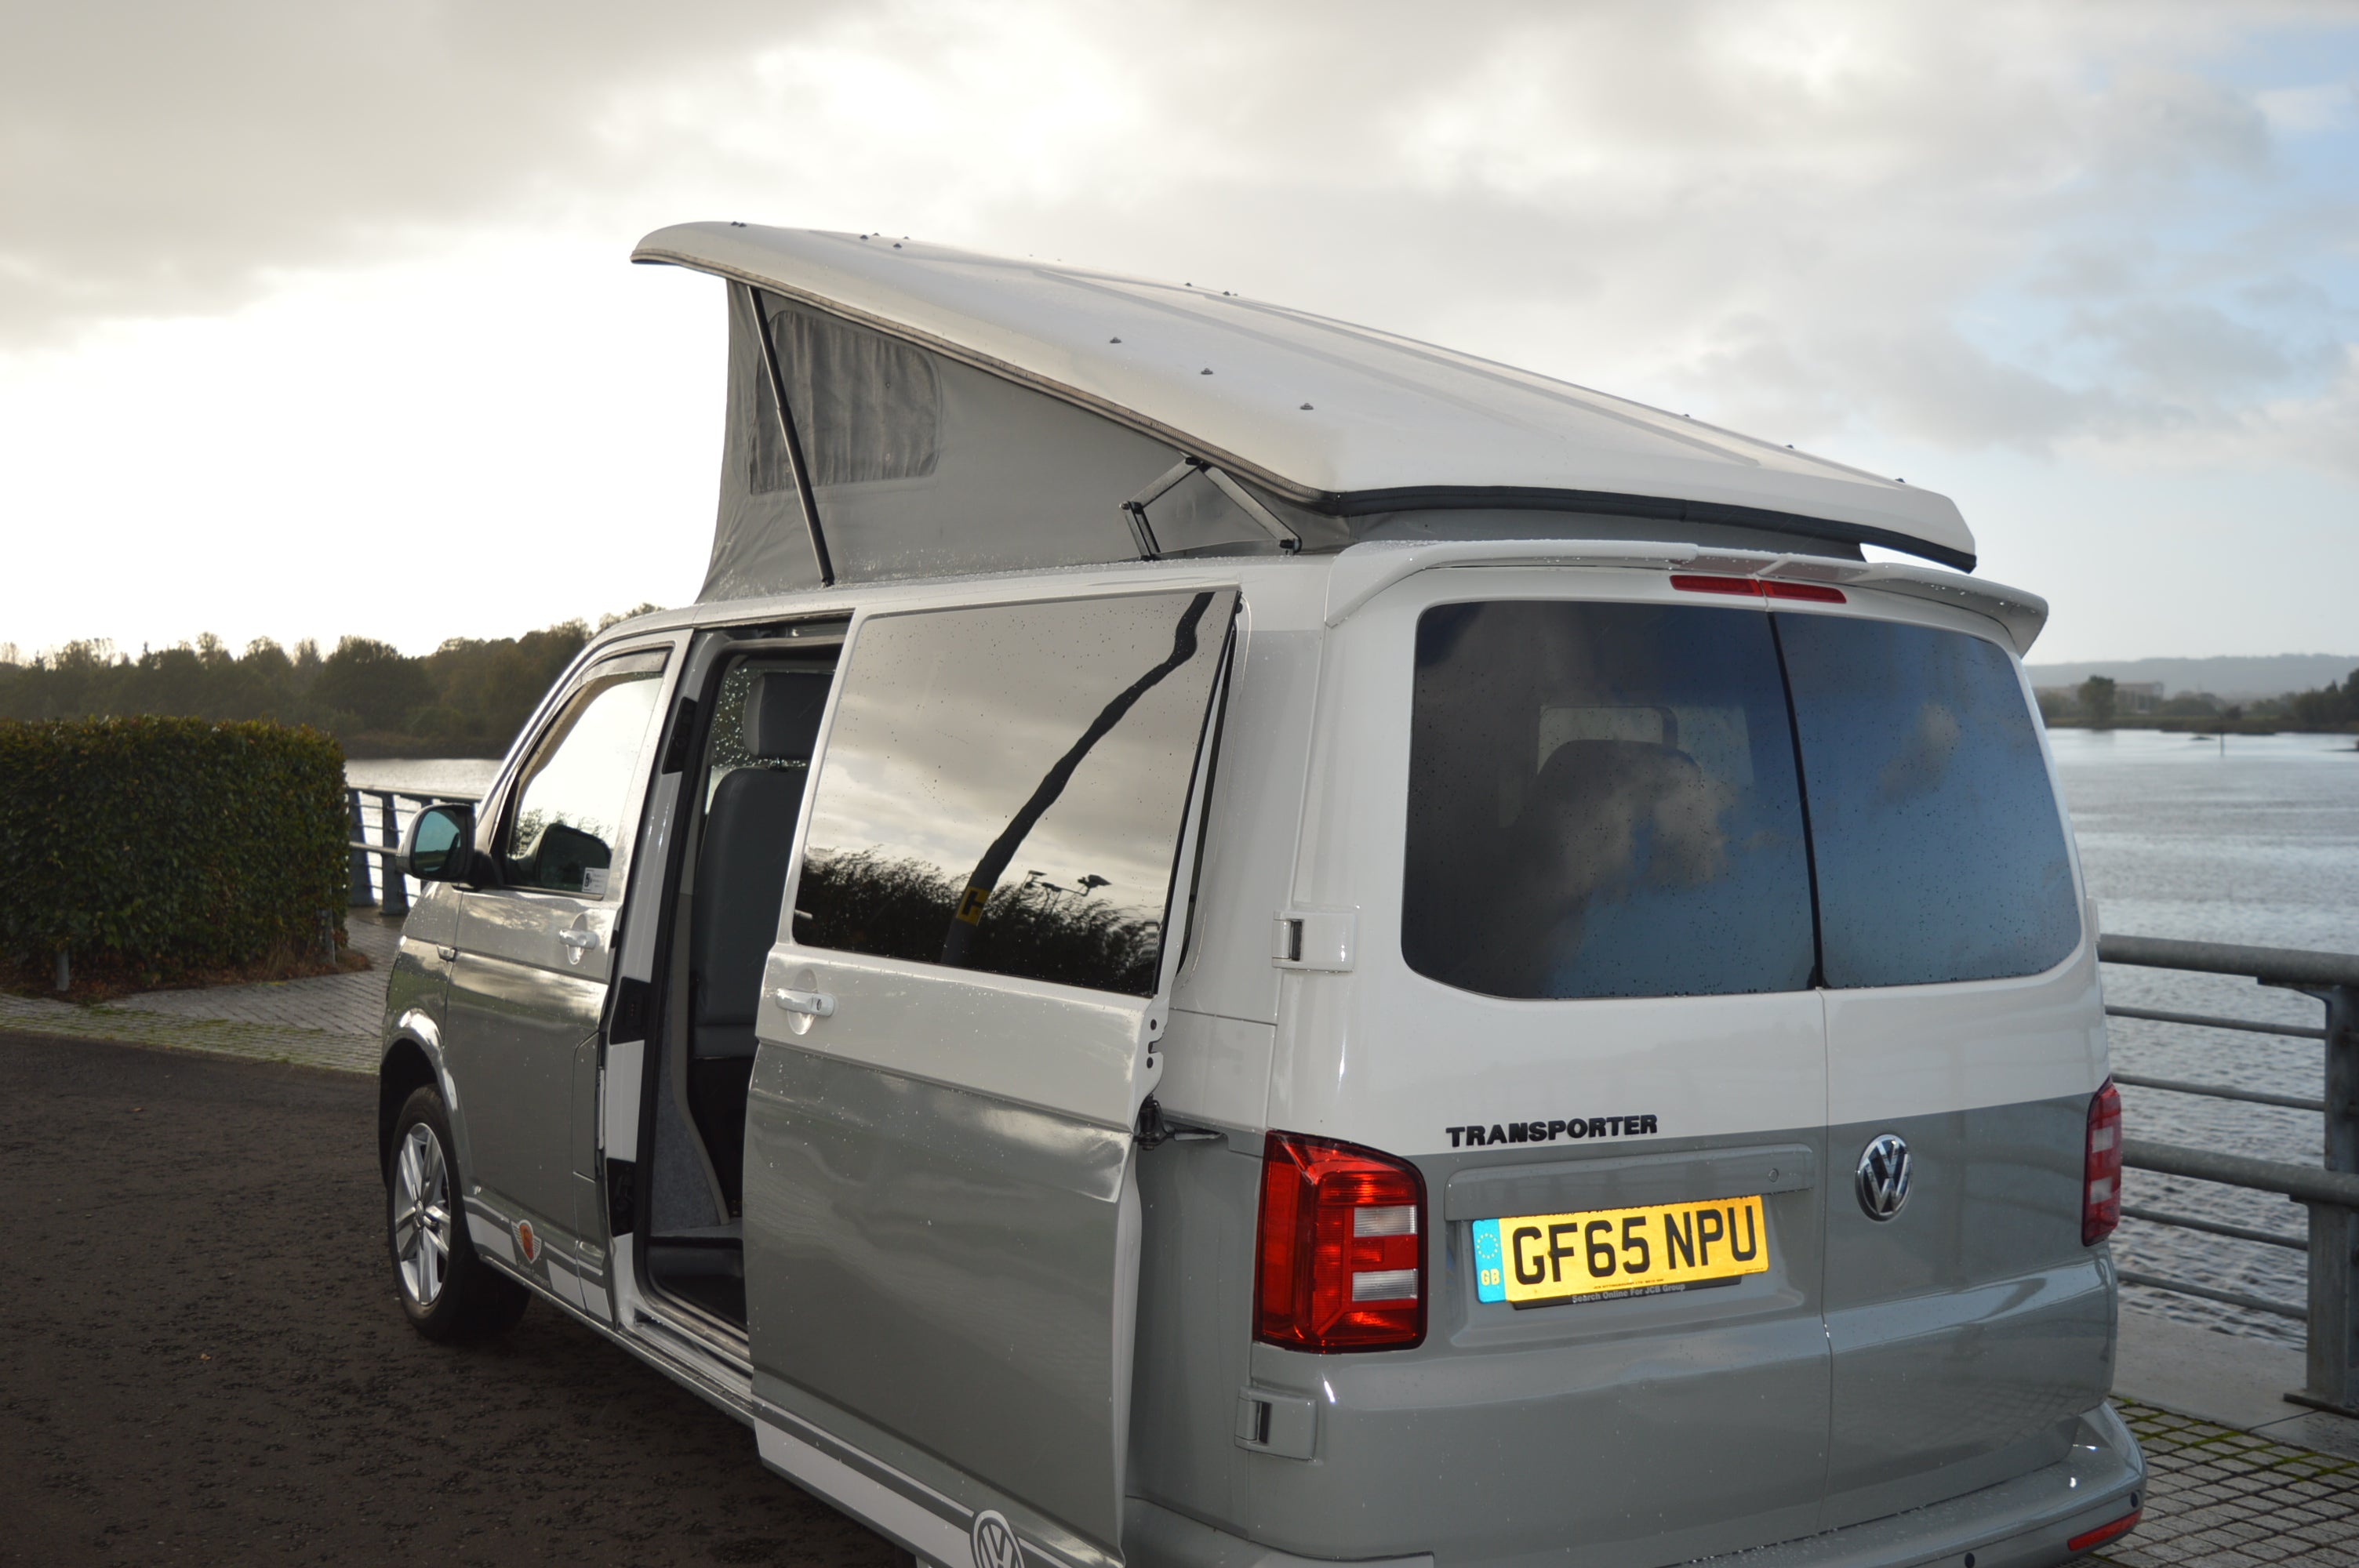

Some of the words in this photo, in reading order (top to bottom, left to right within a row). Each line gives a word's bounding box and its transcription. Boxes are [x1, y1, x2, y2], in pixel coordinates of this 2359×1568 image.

[1446, 1115, 1658, 1147] TRANSPORTER
[1513, 1217, 1650, 1286] GF65
[1664, 1206, 1757, 1269] NPU
[1481, 1269, 1501, 1286] GB
[1572, 1294, 1601, 1304] Search
[1603, 1290, 1628, 1299] Online
[1630, 1288, 1644, 1297] For
[1645, 1285, 1661, 1294] JCB
[1662, 1283, 1686, 1293] Group
